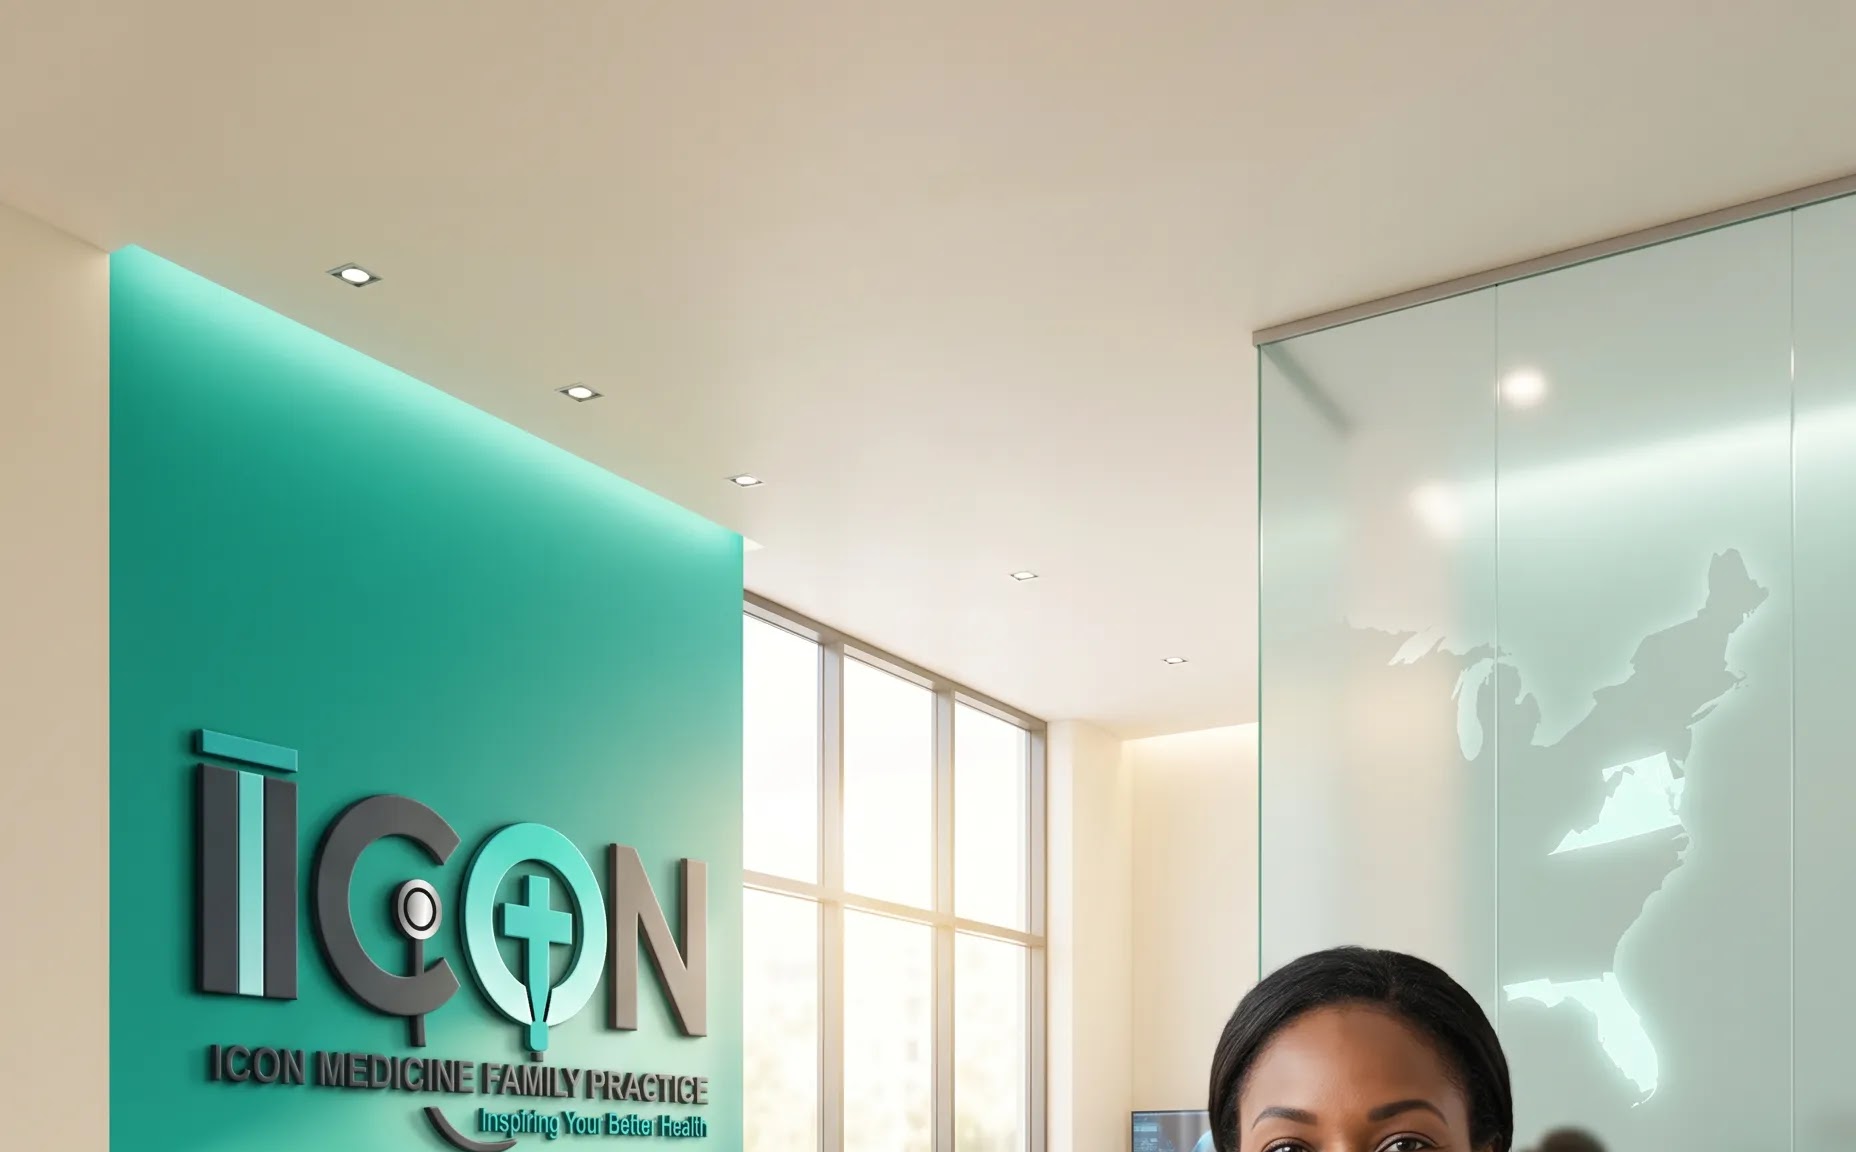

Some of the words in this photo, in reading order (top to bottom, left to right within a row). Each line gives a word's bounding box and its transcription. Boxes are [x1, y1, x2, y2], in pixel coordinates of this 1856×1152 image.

[195, 729, 708, 1048] ICON
[210, 1044, 305, 1085] ICON
[316, 1050, 474, 1093] MEDICINE
[481, 1062, 580, 1098] FAMILY
[586, 1069, 709, 1105] PRACTICE
[478, 1108, 559, 1140] Inspiring
[561, 1110, 603, 1134] Your
[605, 1112, 655, 1136] Better
[657, 1115, 707, 1137] Health
